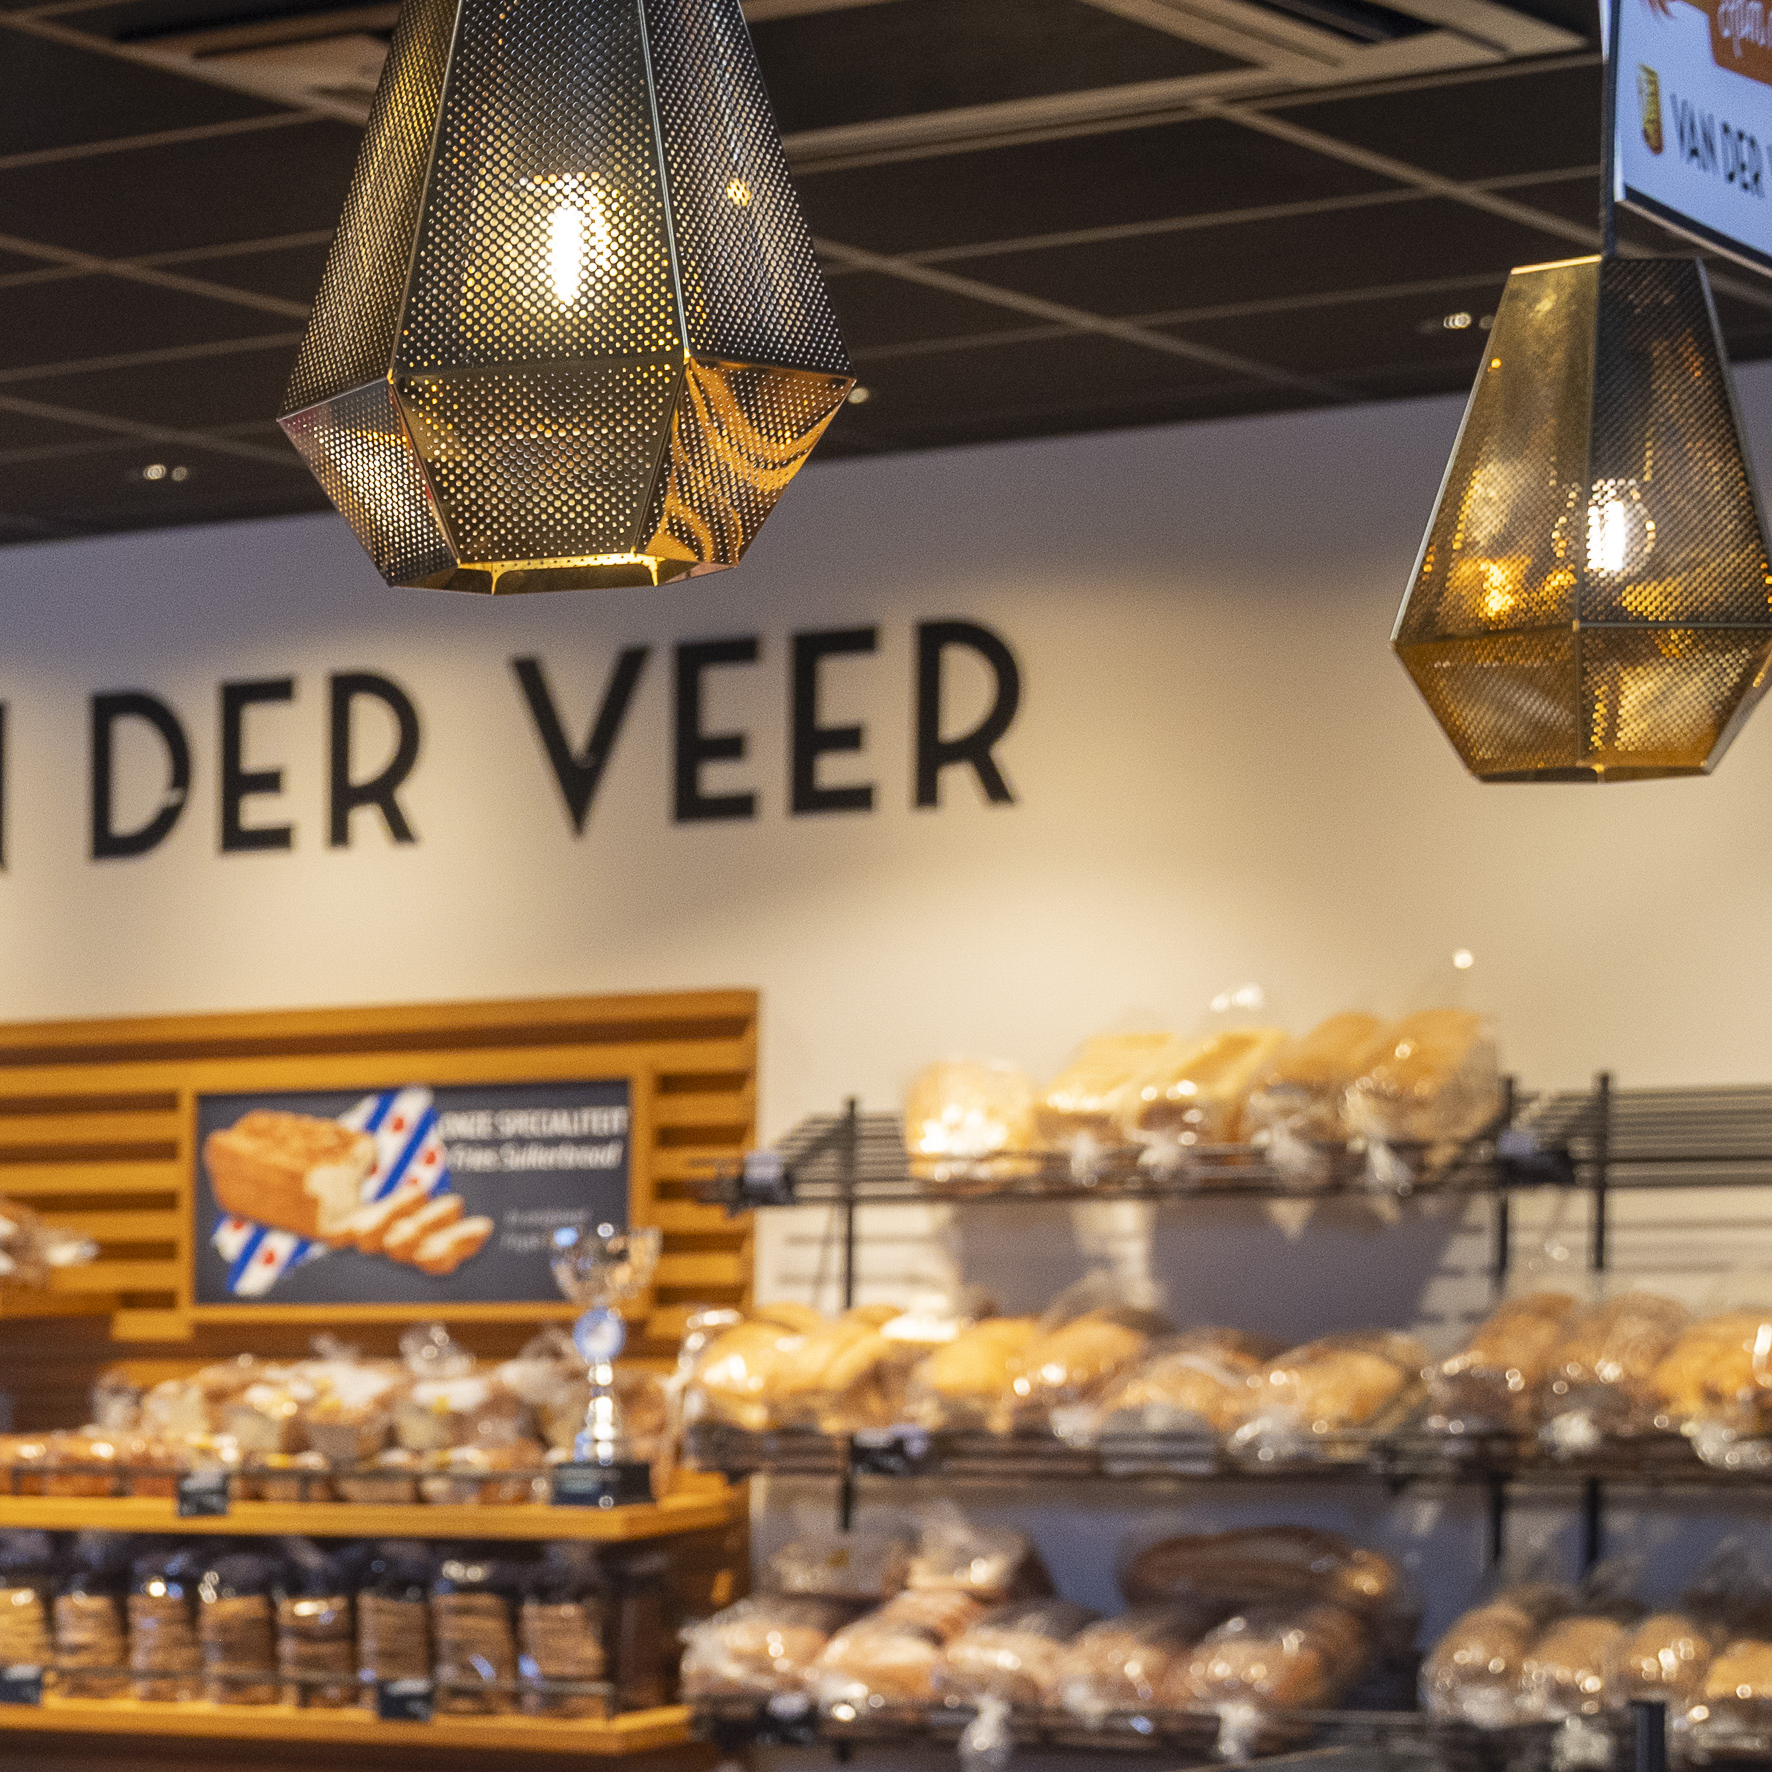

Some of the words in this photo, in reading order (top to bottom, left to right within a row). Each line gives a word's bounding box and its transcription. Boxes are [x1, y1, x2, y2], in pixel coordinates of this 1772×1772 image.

[1669, 92, 1720, 177] VAN
[1719, 120, 1766, 199] DER
[88, 670, 421, 862] DER
[510, 616, 1023, 840] VEER
